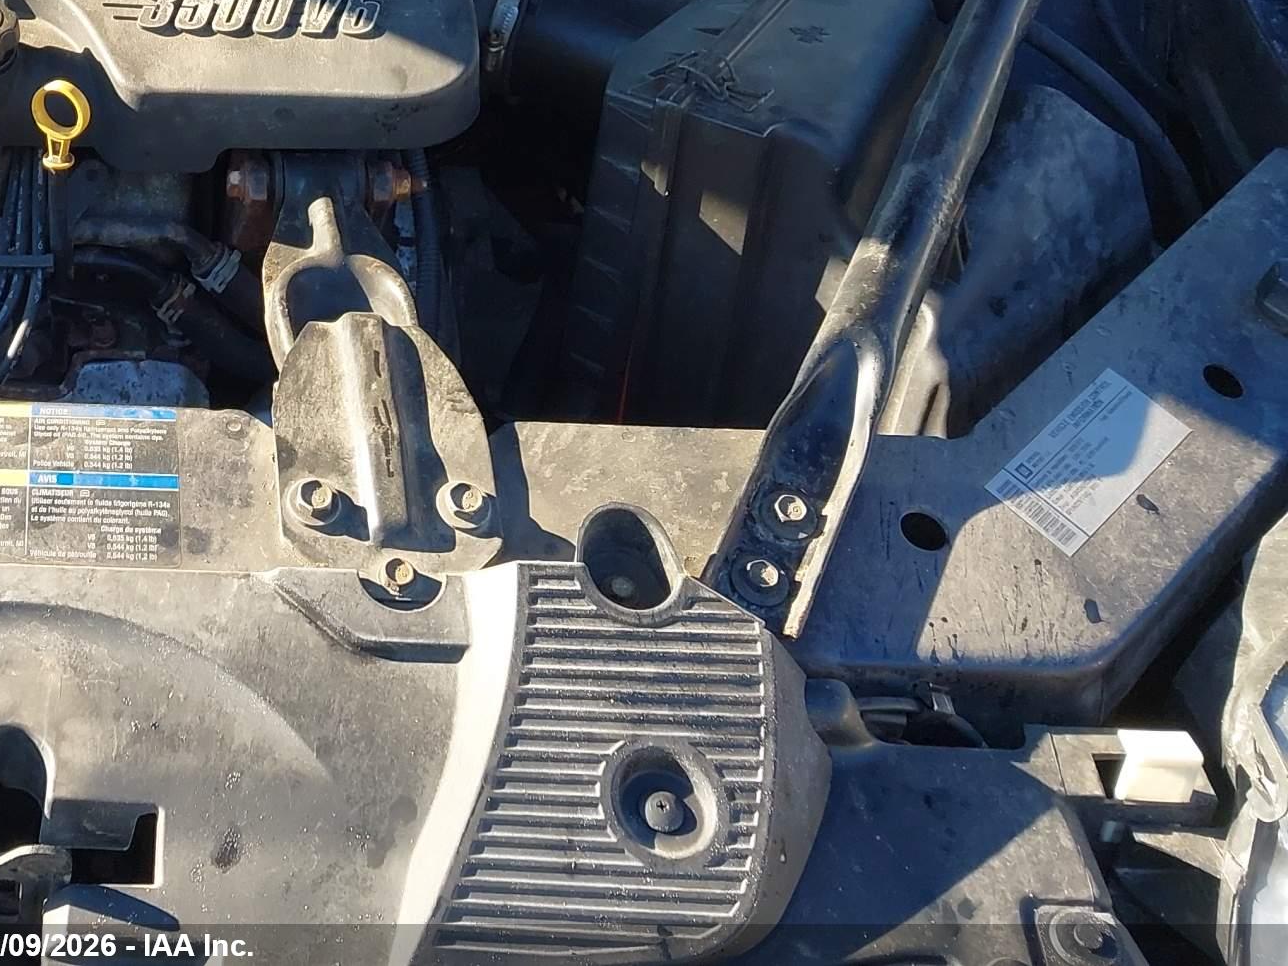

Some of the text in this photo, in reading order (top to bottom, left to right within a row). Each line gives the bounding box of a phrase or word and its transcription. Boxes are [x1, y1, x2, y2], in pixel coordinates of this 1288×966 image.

[38, 474, 56, 482] AVIS
[1, 487, 19, 495] SOUS
[31, 488, 73, 496] CLIMATISEUR
[147, 500, 171, 508] R-134a
[39, 514, 66, 522] système
[102, 516, 130, 524] colorant.
[100, 525, 161, 534] Charge système
